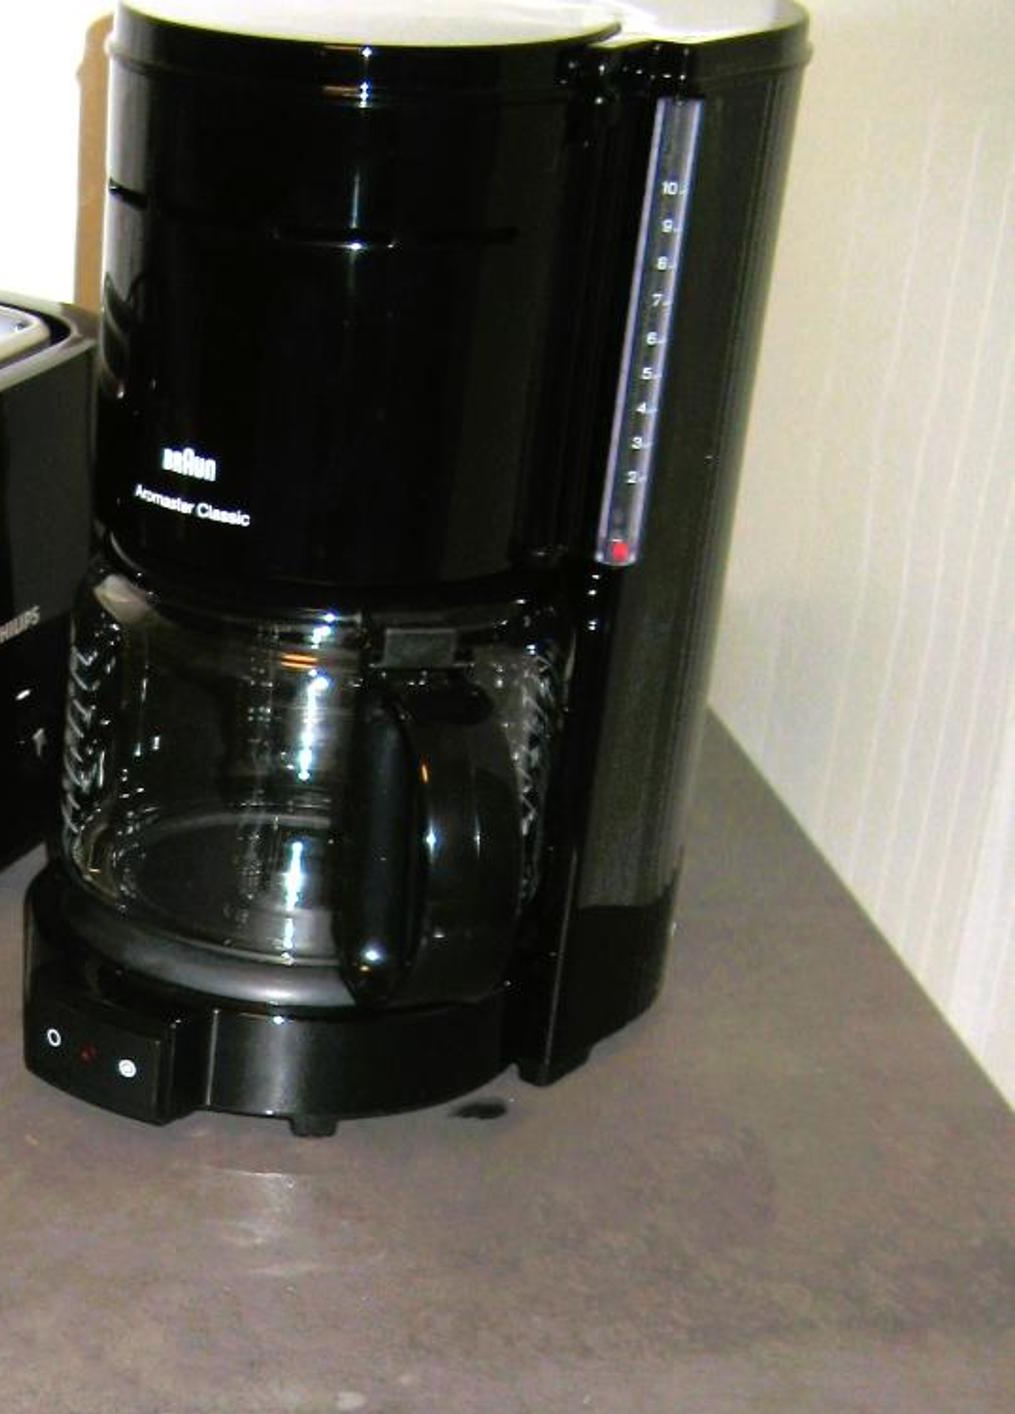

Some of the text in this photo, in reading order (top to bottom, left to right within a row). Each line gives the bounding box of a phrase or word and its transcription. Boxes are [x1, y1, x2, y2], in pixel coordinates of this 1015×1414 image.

[661, 181, 678, 196] 10
[651, 293, 663, 307] 7
[646, 331, 658, 345] 6
[641, 367, 653, 381] 5
[636, 402, 648, 414] 4
[631, 436, 643, 450] 3
[626, 470, 638, 484] 2
[196, 502, 251, 527] Classic
